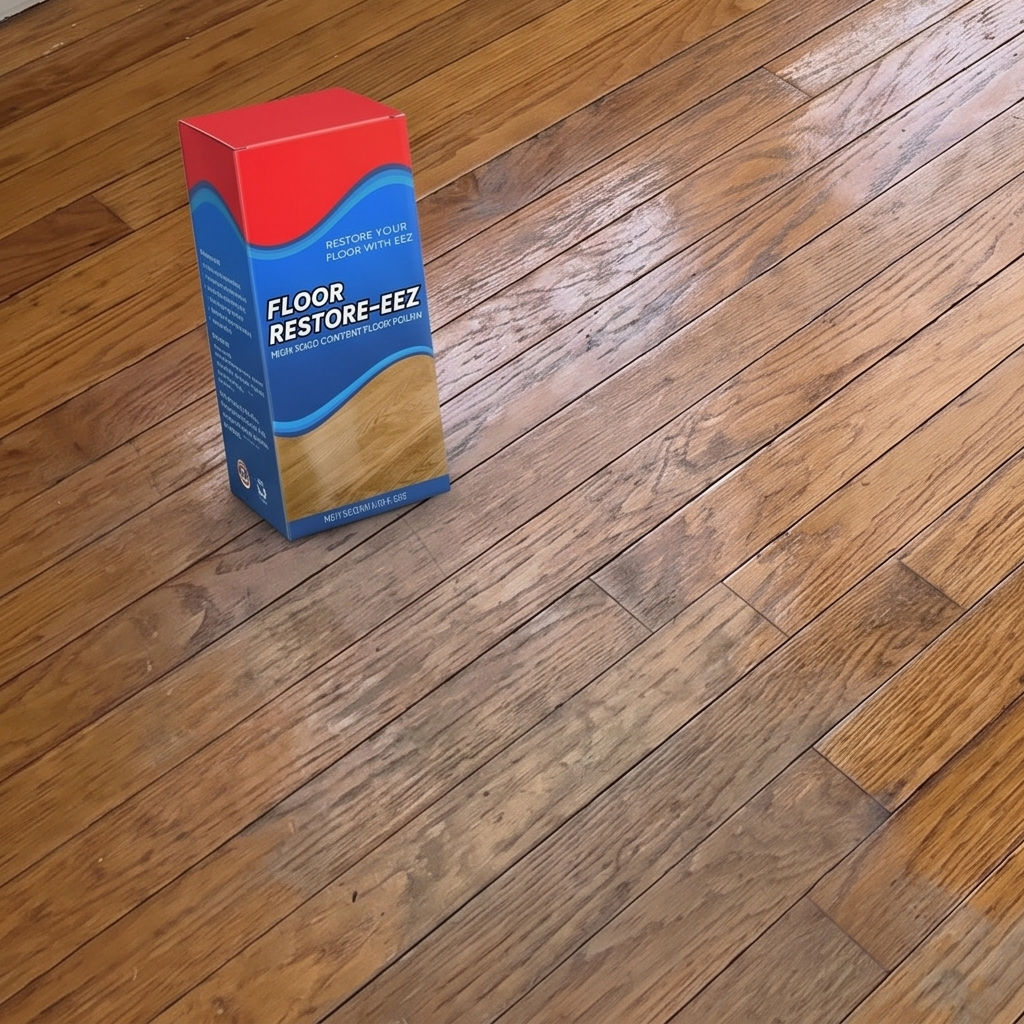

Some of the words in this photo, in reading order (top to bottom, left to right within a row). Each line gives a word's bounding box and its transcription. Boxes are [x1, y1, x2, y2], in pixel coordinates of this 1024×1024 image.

[326, 231, 373, 250] RESTORE
[376, 222, 407, 236] YOUR
[364, 239, 391, 252] WITH
[394, 233, 413, 245] EEZ
[267, 282, 344, 321] FLOOR
[269, 284, 421, 346] RESTORE-EEZ
